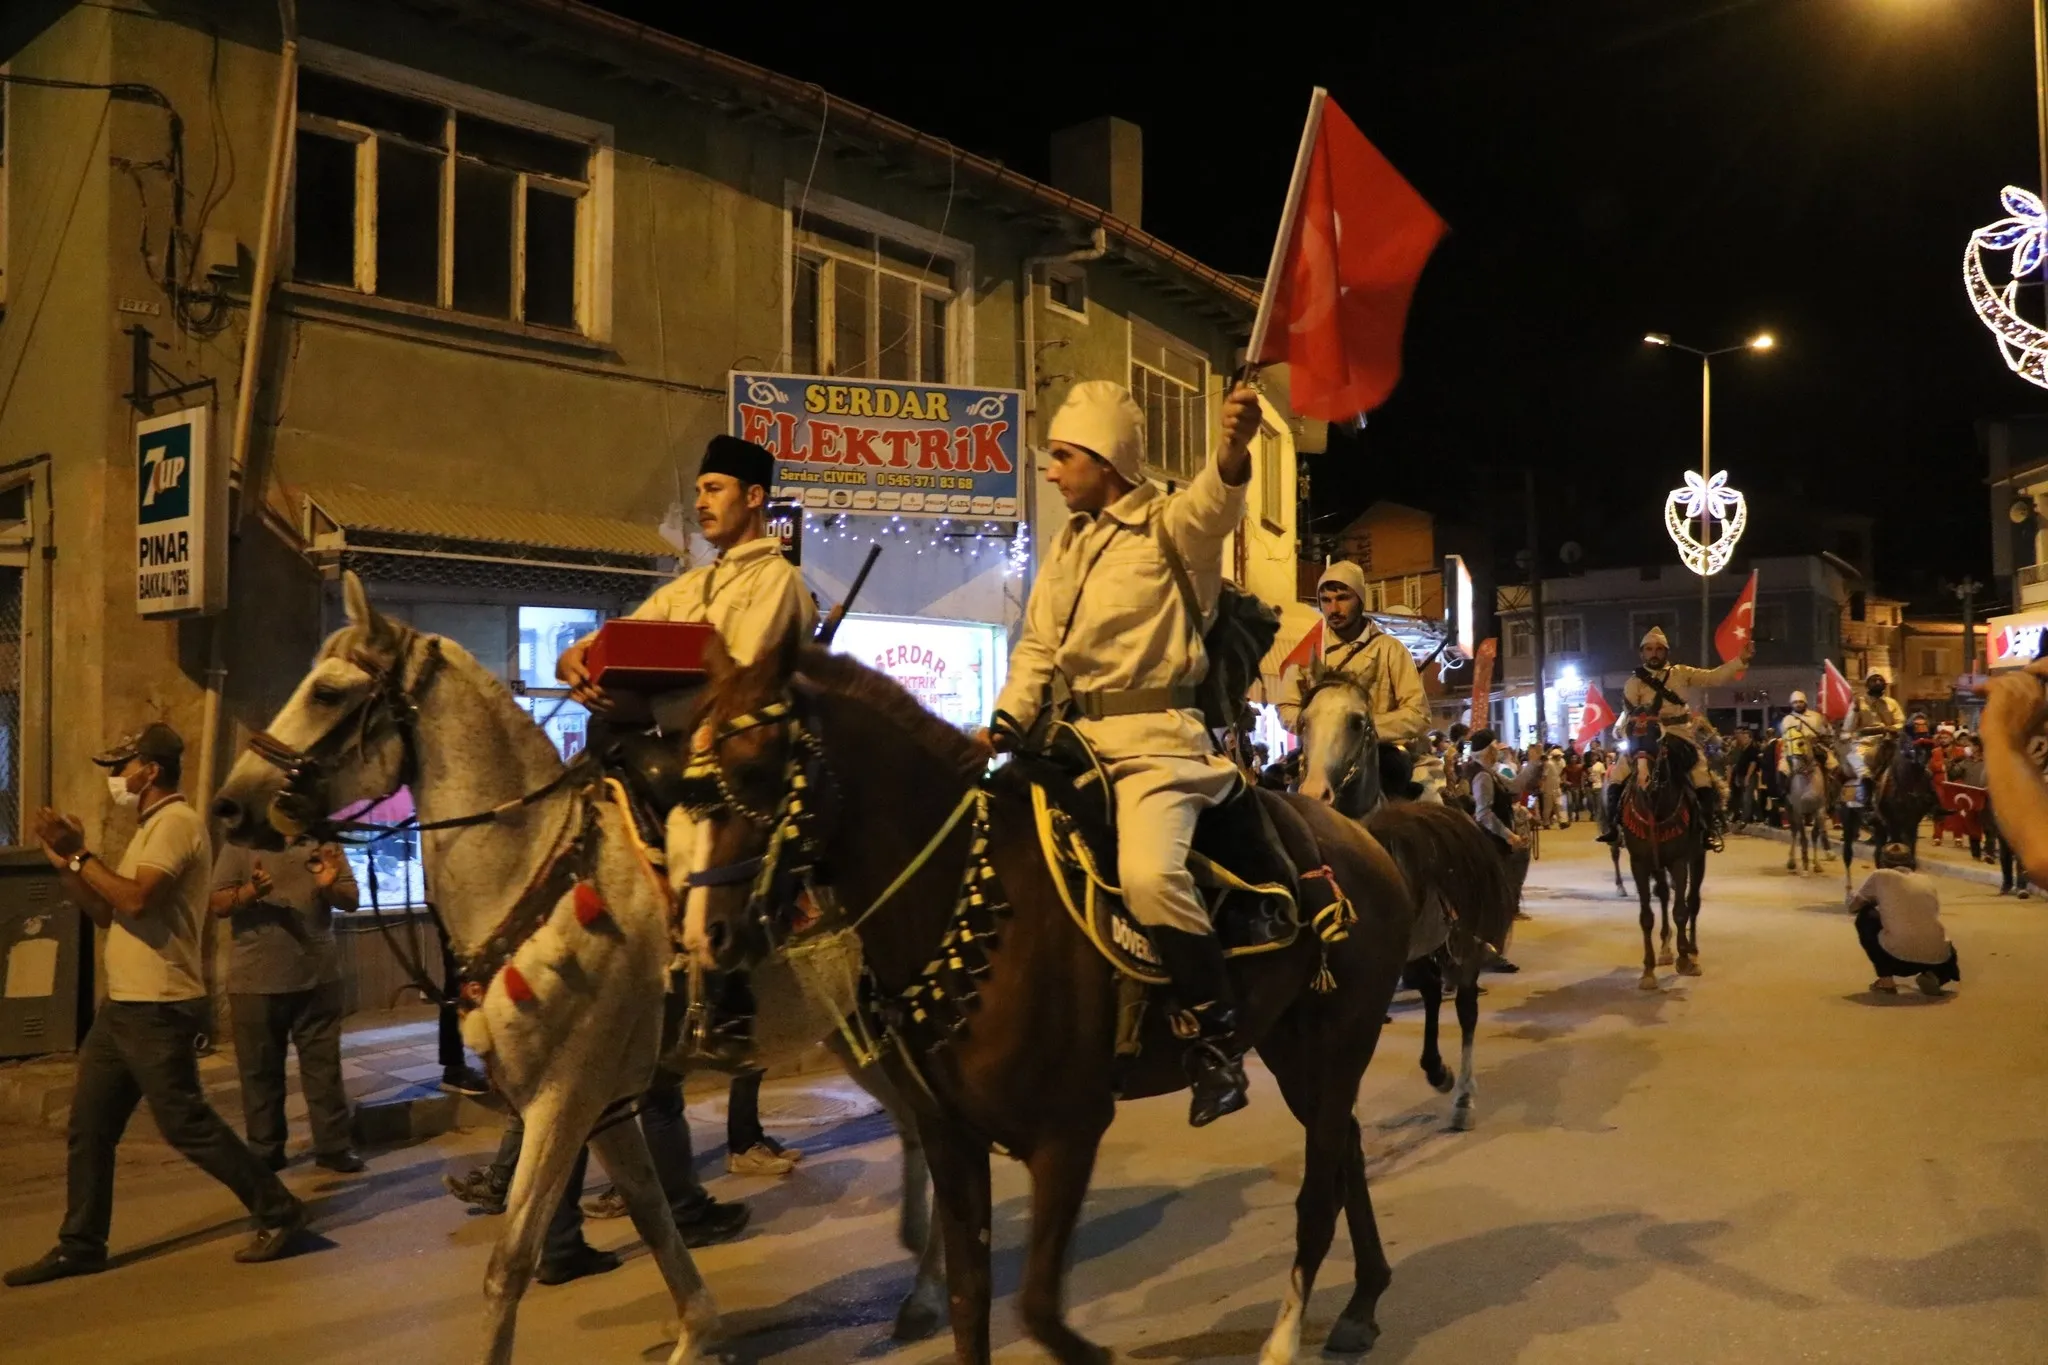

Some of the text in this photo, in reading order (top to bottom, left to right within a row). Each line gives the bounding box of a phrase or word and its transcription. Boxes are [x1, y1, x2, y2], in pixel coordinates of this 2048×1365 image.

[804, 384, 950, 421] SERDAR
[780, 468, 820, 482] Serdar
[877, 473, 885, 486] 0
[888, 473, 911, 486] 545
[914, 474, 935, 488] 371
[139, 530, 189, 567] PINAR
[875, 645, 946, 678] SERDAR
